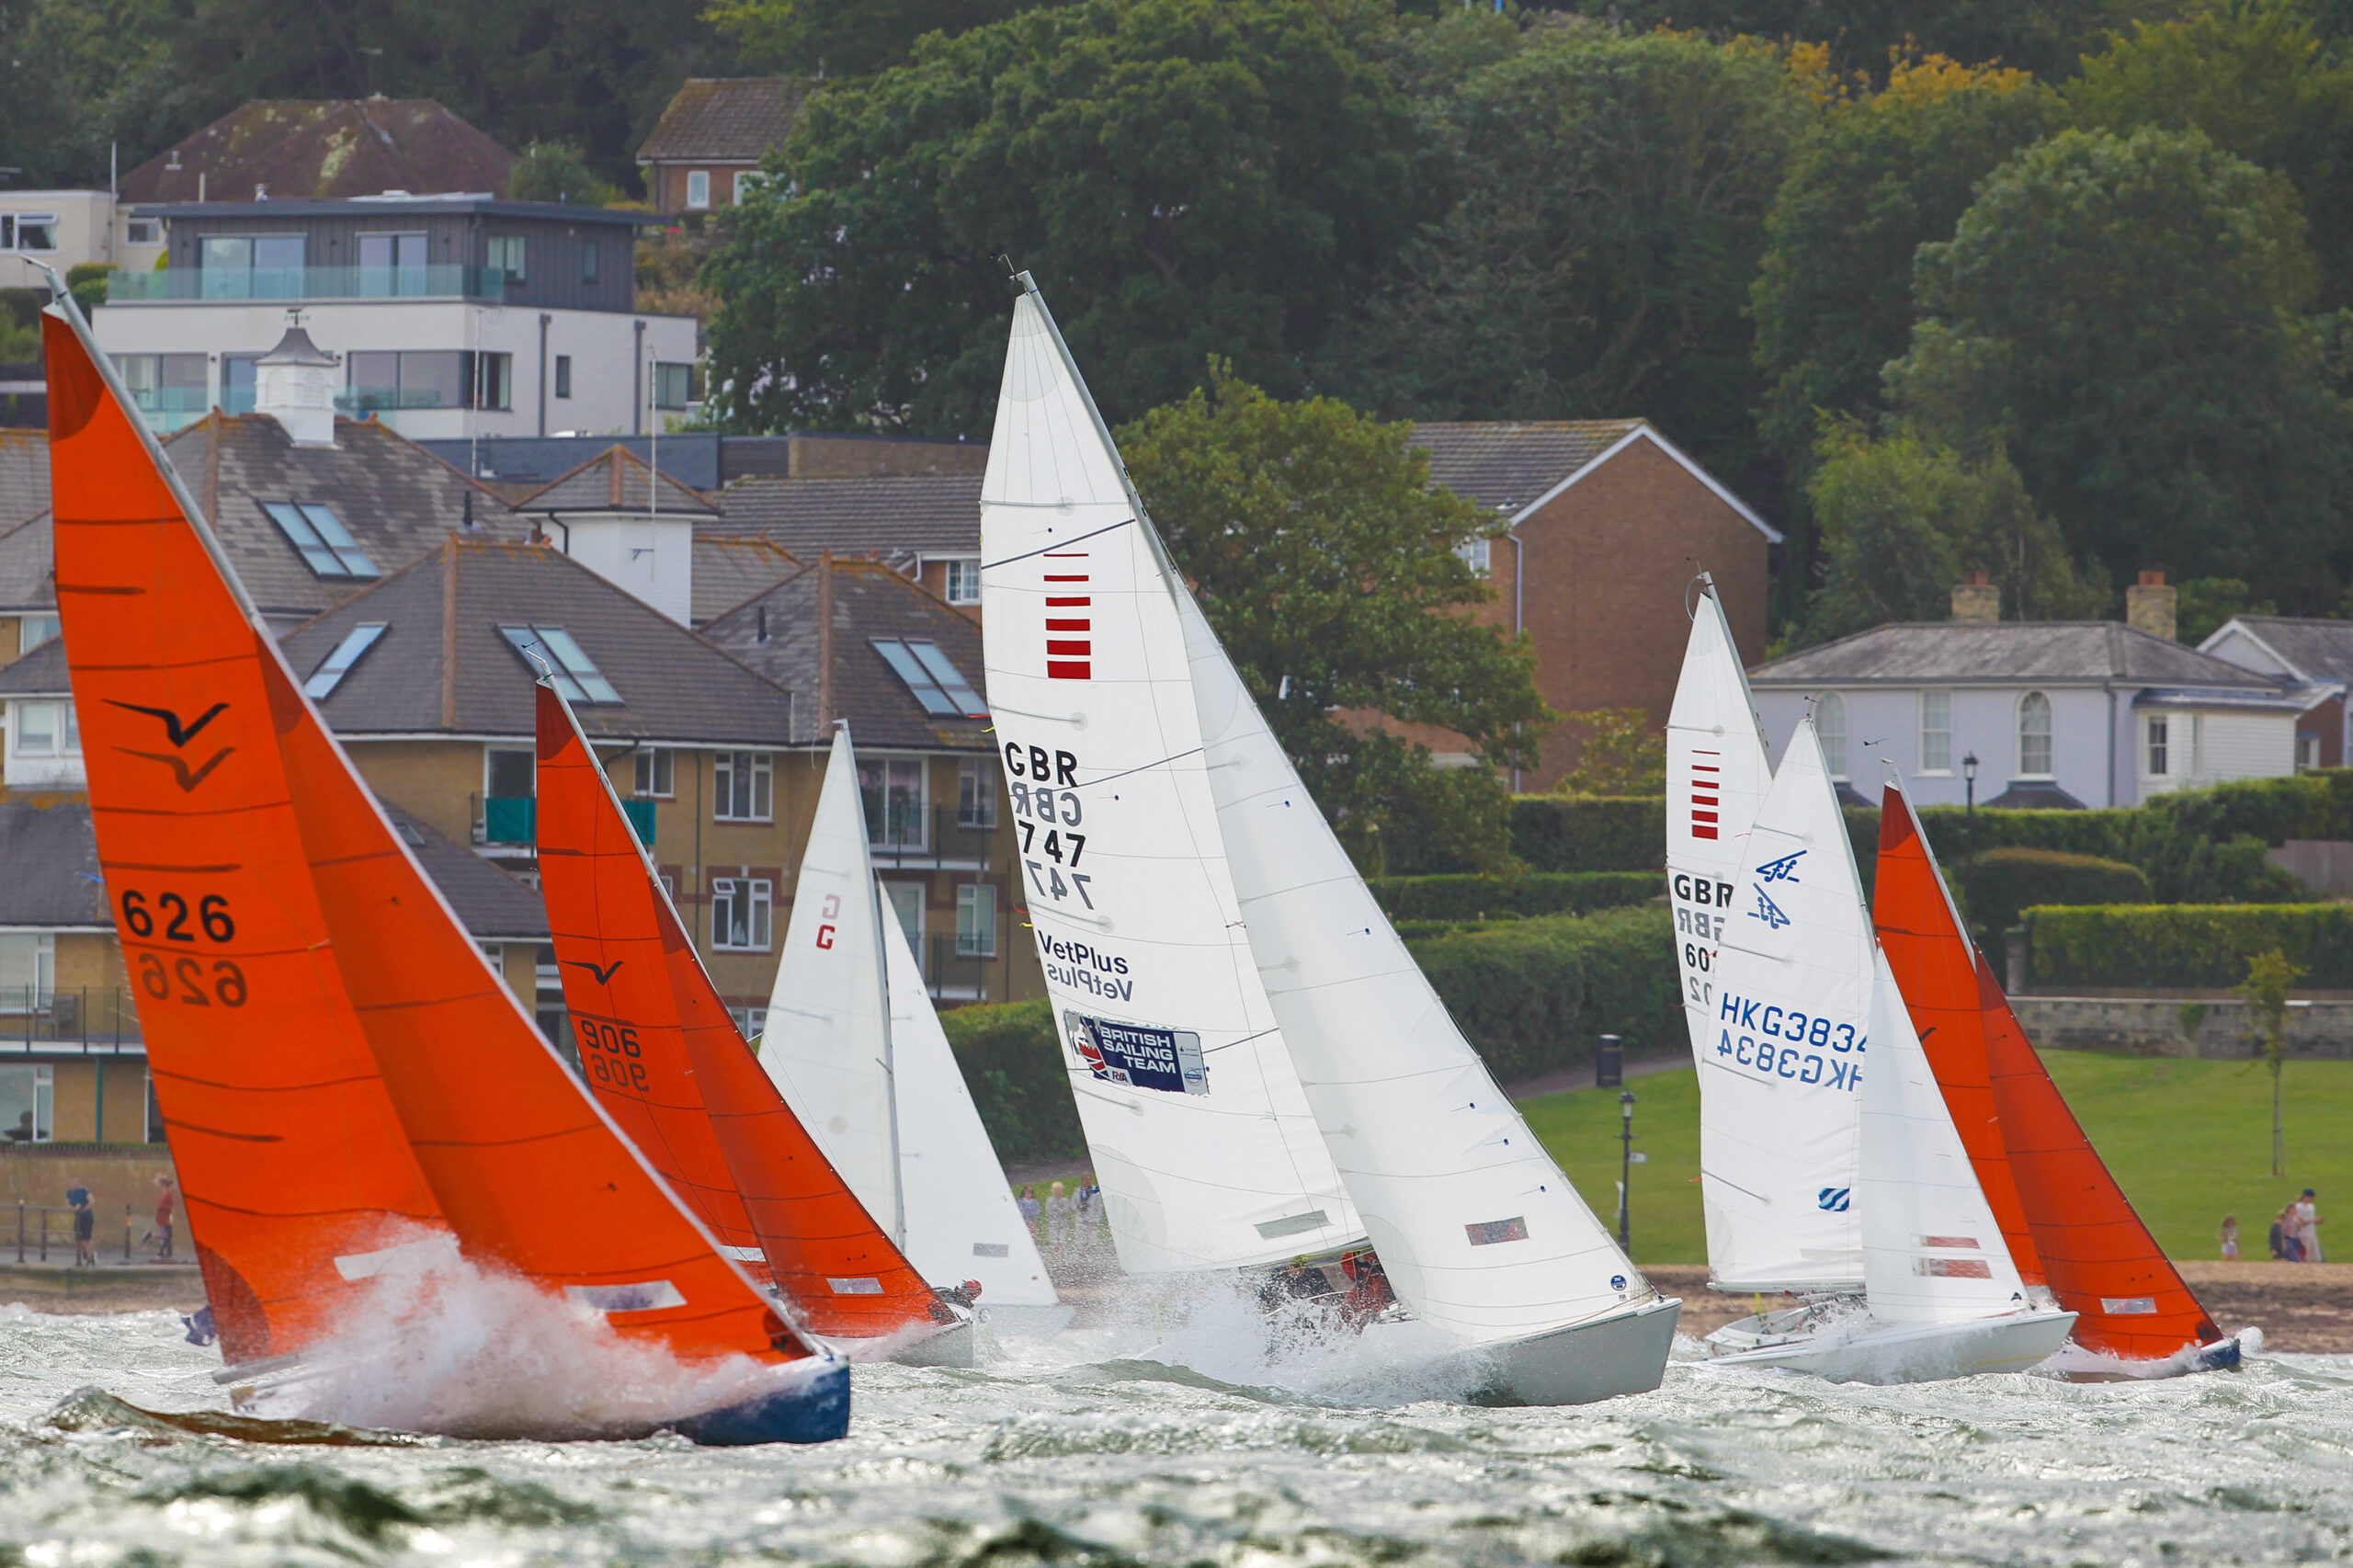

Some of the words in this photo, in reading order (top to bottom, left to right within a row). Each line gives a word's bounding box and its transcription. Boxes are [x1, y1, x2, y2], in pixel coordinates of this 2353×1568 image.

[1006, 742, 1078, 788] GBR
[1018, 820, 1086, 867] 747
[1675, 874, 1733, 908] GBR
[122, 889, 234, 943] 626
[816, 925, 835, 949] G
[1037, 930, 1129, 974] VetPlus
[1685, 942, 1718, 972] 60
[581, 1019, 641, 1058] 906
[1100, 1027, 1171, 1048] BRITISH
[1103, 1039, 1174, 1061] SAILING
[1122, 1055, 1176, 1074] TEAM
